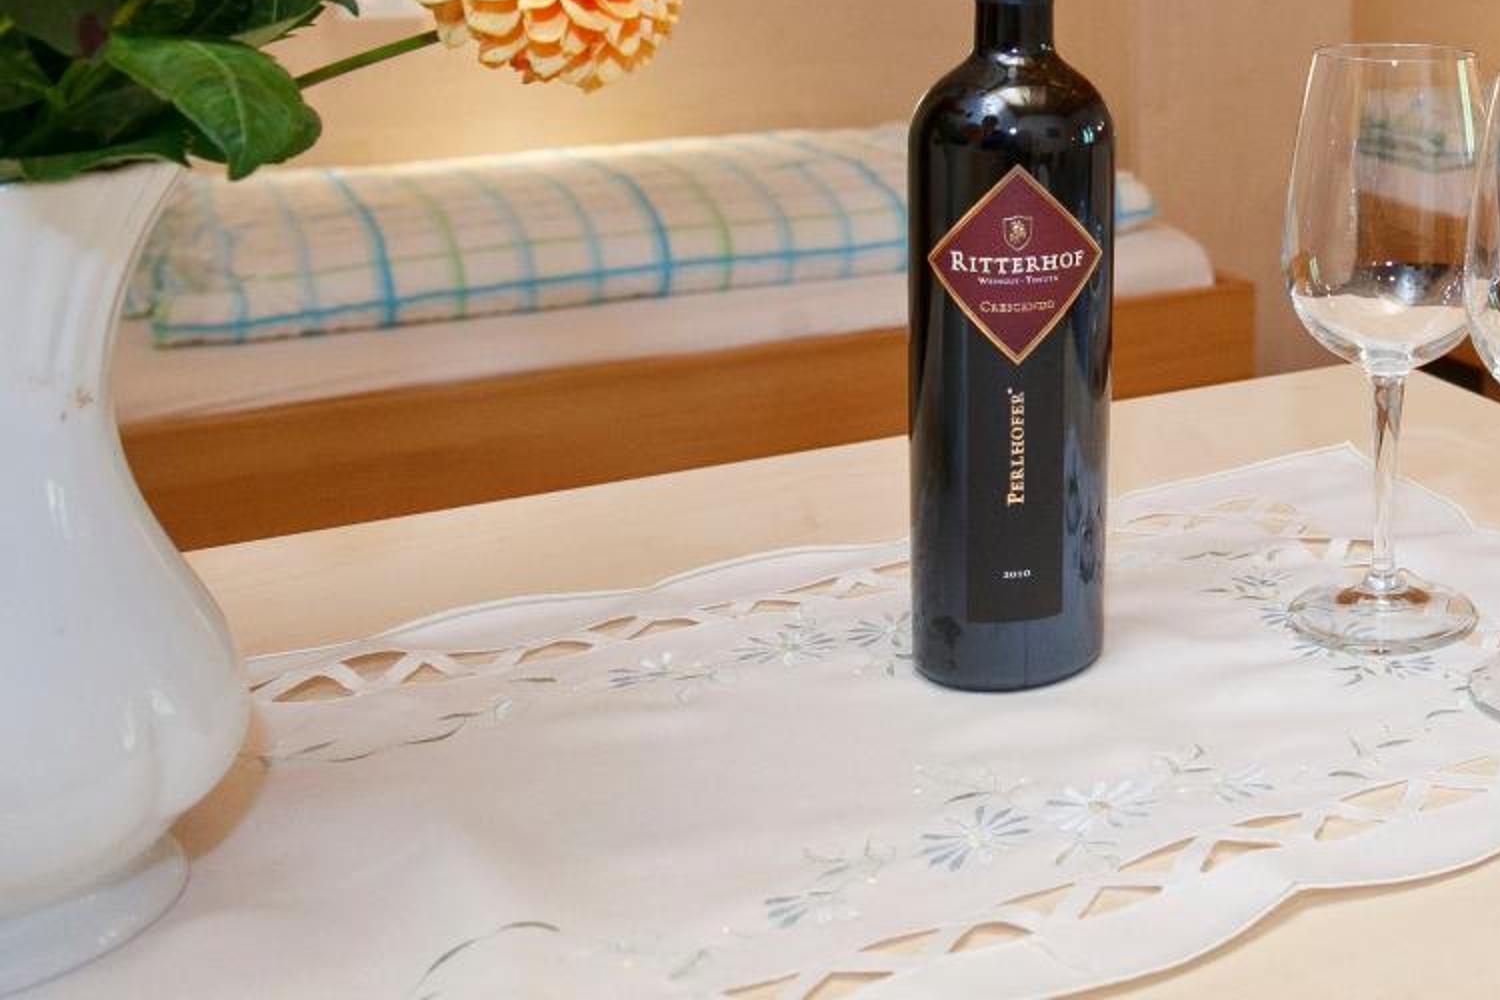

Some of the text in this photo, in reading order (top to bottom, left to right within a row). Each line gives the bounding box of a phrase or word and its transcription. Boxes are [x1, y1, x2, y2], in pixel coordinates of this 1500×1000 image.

[950, 250, 1083, 274] RITTERHOF
[979, 300, 1055, 313] CRESCENDO
[1007, 392, 1025, 506] PERLHOFER
[1003, 570, 1031, 579] 2010
